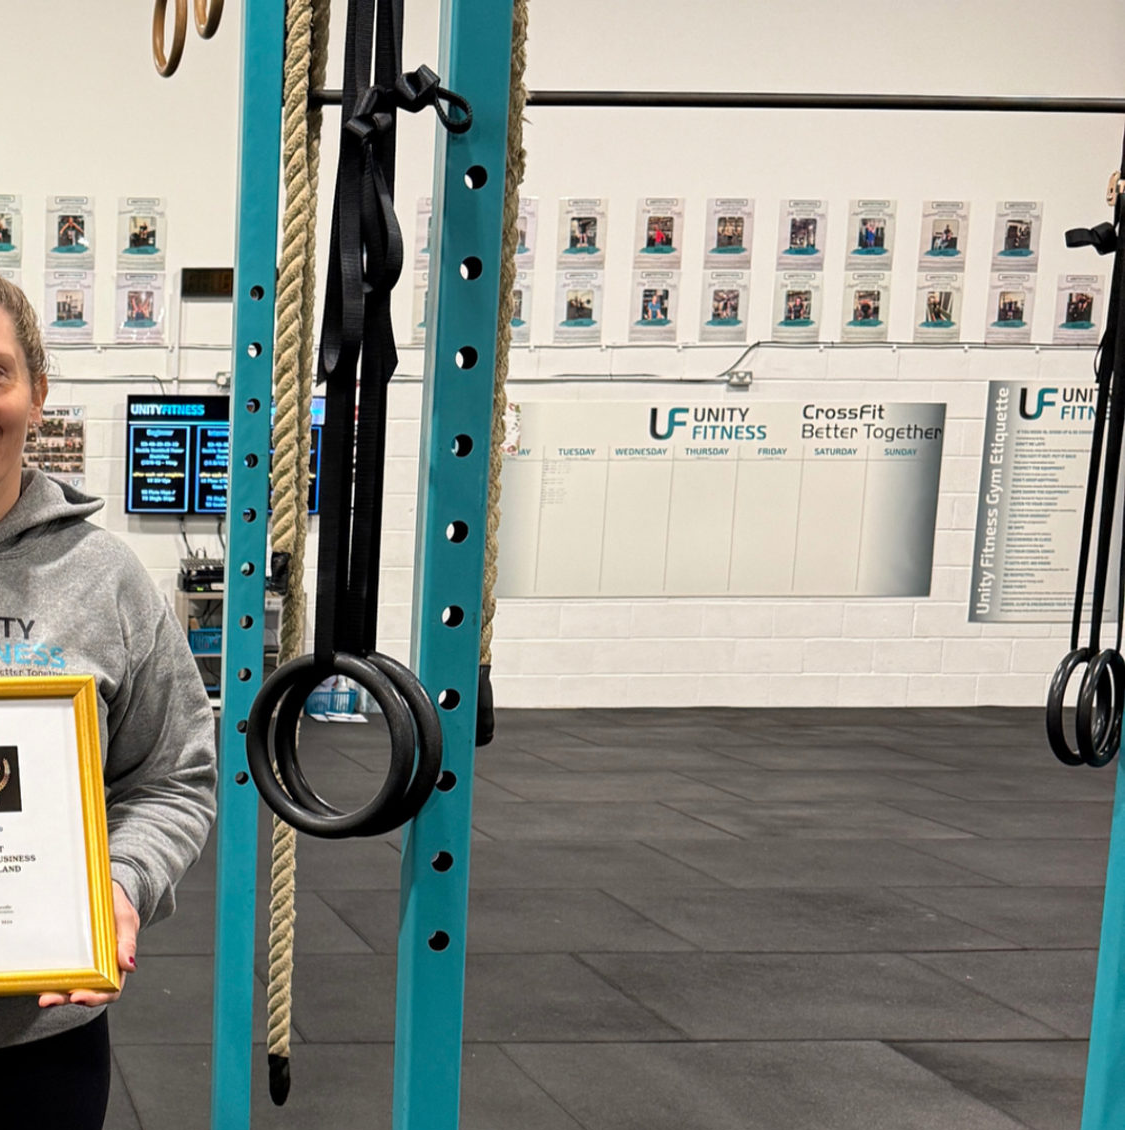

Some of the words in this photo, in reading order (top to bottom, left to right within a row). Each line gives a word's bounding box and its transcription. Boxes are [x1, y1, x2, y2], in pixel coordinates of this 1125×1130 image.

[1062, 387, 1100, 402] UNI
[693, 407, 750, 423] UNITY
[802, 404, 885, 420] CrossFit
[1060, 405, 1096, 420] FITN
[692, 424, 767, 440] FITNESS
[801, 424, 858, 440] Better
[863, 423, 942, 442] Together
[989, 386, 1009, 464] Etiquette
[558, 448, 596, 456] TUESDAY
[615, 448, 668, 456] WEDNESDAY
[685, 448, 730, 456] THURSDAY
[758, 448, 788, 456] FRIDAY
[814, 448, 858, 456] SATURDAY
[884, 448, 917, 456] SUNDAY
[985, 468, 1003, 505] Gym
[979, 508, 998, 567] Fitness
[976, 571, 995, 614] Unity
